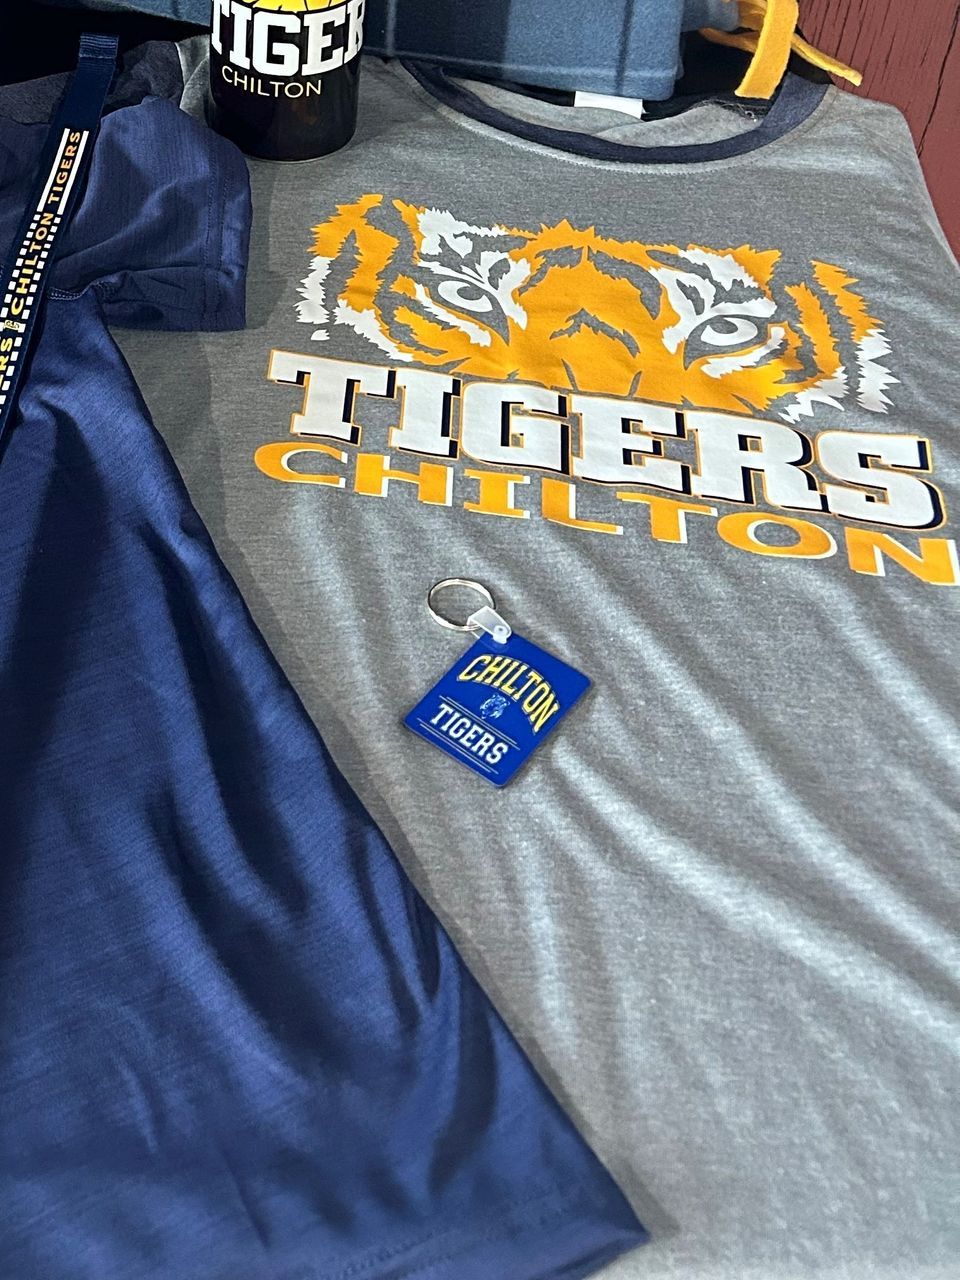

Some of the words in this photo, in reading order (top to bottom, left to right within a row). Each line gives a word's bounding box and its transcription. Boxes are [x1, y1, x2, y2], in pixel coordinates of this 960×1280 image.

[221, 65, 322, 98] CHILTON
[10, 212, 54, 316] CHILTON
[47, 131, 81, 205] TIGERS
[267, 349, 947, 531] TIGERS
[254, 442, 960, 586] CHILTON
[430, 702, 509, 764] TIGERS
[456, 654, 560, 735] CHILTON
